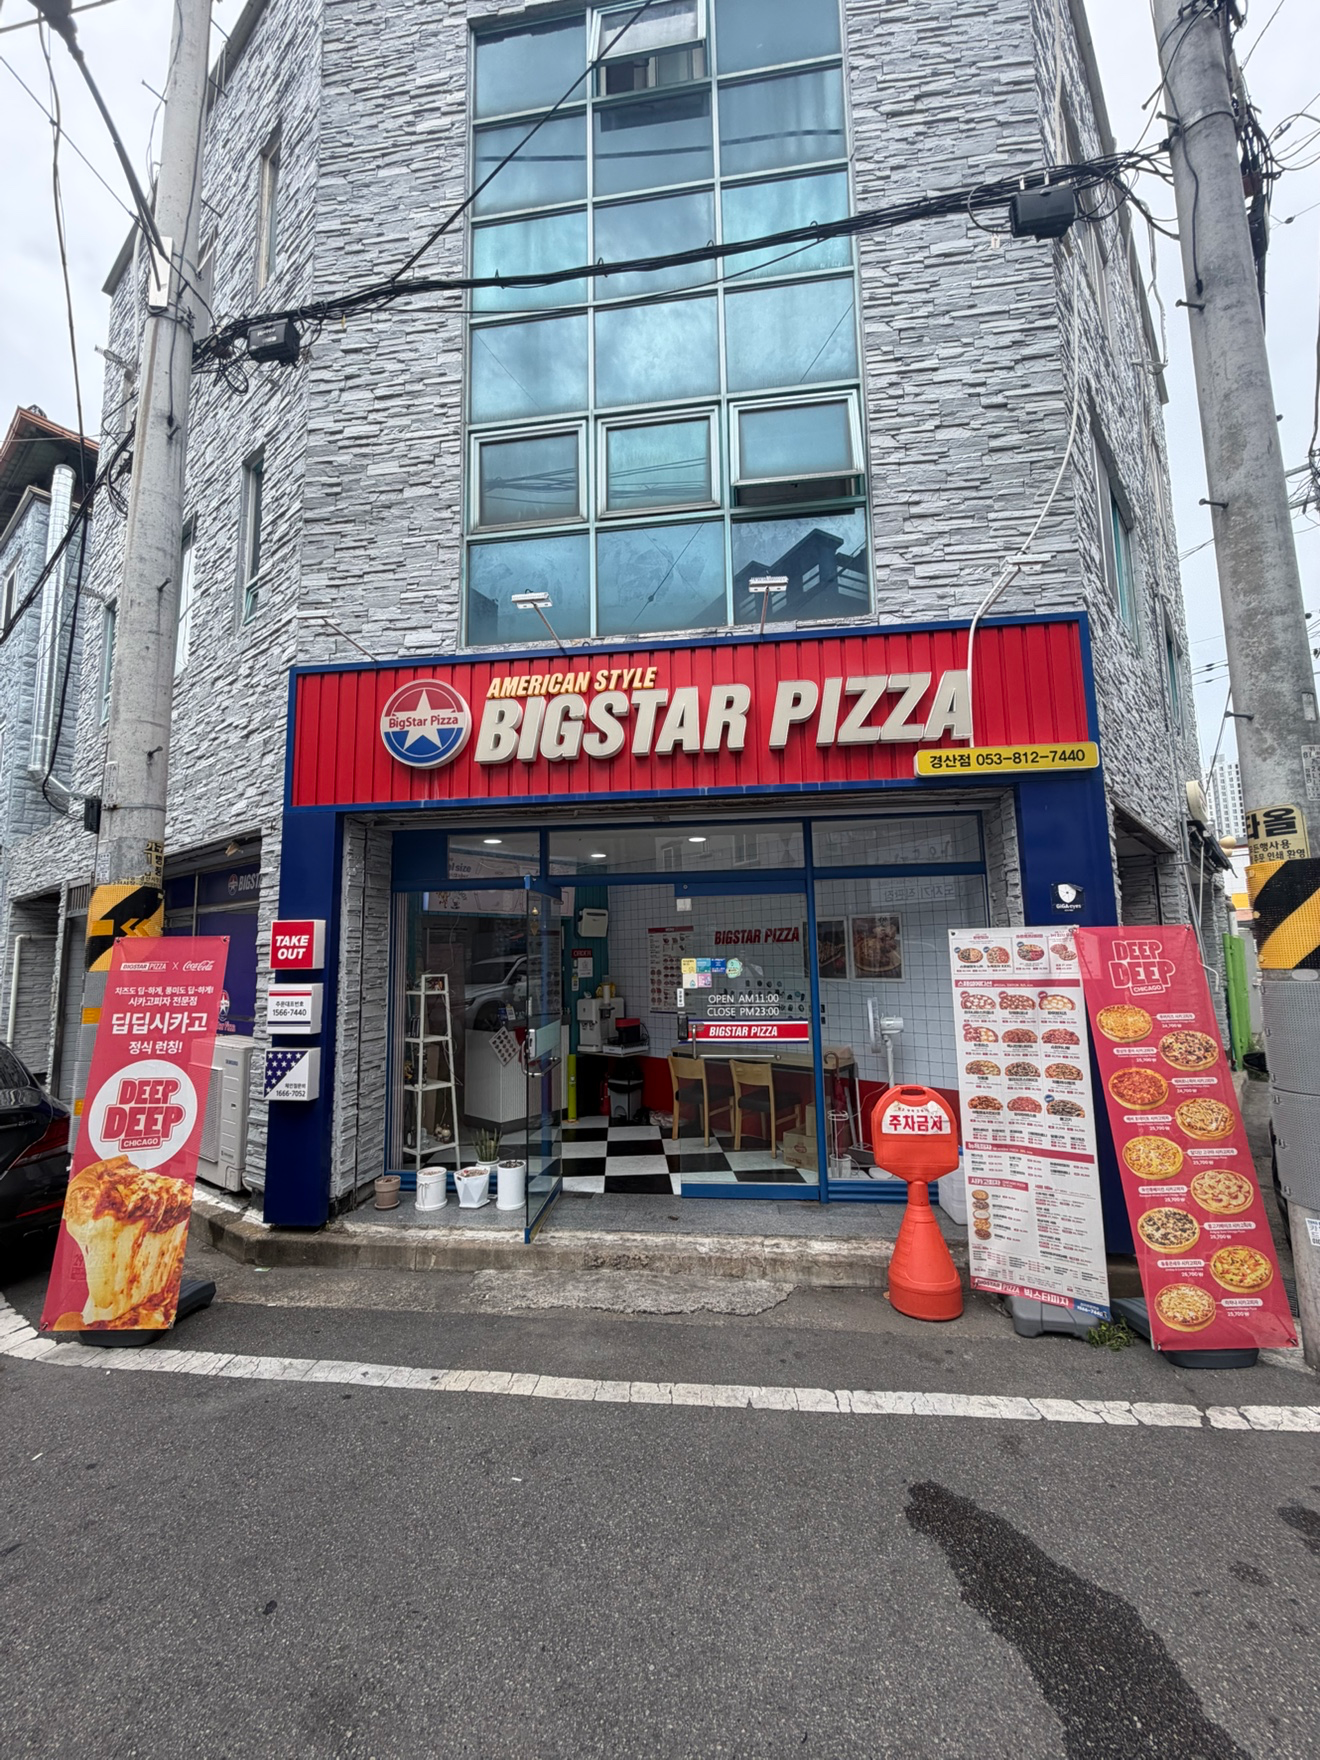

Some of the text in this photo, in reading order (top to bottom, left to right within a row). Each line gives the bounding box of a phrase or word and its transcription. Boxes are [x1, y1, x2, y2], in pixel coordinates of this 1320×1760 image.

[486, 667, 657, 699] AMERICAN STYLE
[389, 714, 458, 730] BigStar Pizza
[474, 669, 973, 765] BIGSTAR PIZZA
[930, 749, 1086, 769] 경산점 053-812-7440
[275, 935, 309, 947] TAKE
[714, 927, 800, 945] BIGSTAR PIZZA
[277, 948, 306, 960] OUT
[1111, 940, 1163, 962] DEEP
[1108, 959, 1176, 989] DEEP
[1133, 984, 1161, 992] CHICAGO
[128, 996, 198, 1006] 시카고피자 전문점
[708, 994, 735, 1003] OPEN
[272, 1009, 307, 1017] 1566-7440
[707, 1007, 736, 1016] CLOSE
[111, 1012, 208, 1035] 딥딥시카고
[709, 1026, 778, 1037] BIGSTAR PIZZA
[128, 1040, 183, 1054] 정식 런칭!
[118, 1078, 181, 1105] DEEP
[101, 1104, 186, 1141] DEEP
[123, 1138, 159, 1148] CHICAGO
[1023, 1287, 1070, 1307] 빅스타피자
